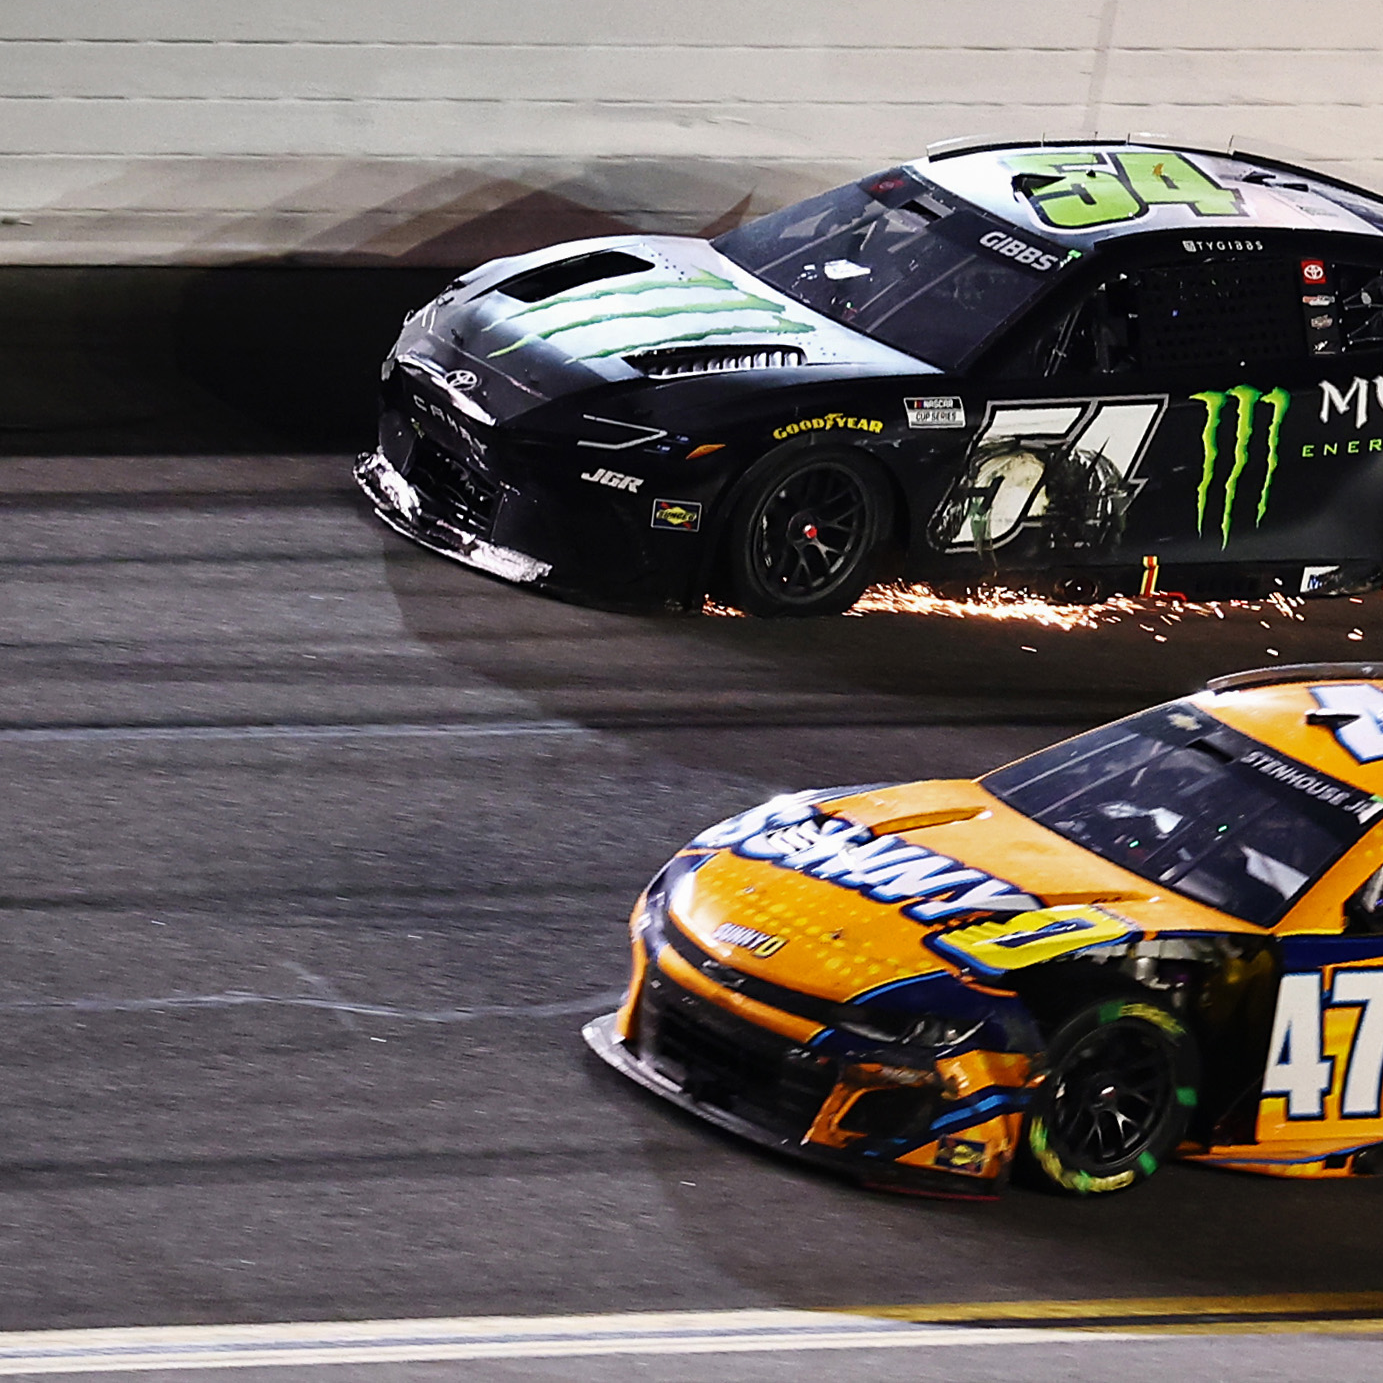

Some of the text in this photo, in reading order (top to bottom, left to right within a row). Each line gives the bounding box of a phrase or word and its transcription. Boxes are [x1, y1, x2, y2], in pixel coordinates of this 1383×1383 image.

[1003, 151, 1251, 231] 54
[979, 231, 1059, 271] GIBBS
[915, 411, 956, 422] CUP SERIES
[922, 398, 954, 409] NASCAR
[412, 393, 489, 457] CAMRY
[772, 412, 884, 440] GOODYEAR
[580, 467, 645, 494] JGR
[1240, 750, 1351, 806] STENHOUSE
